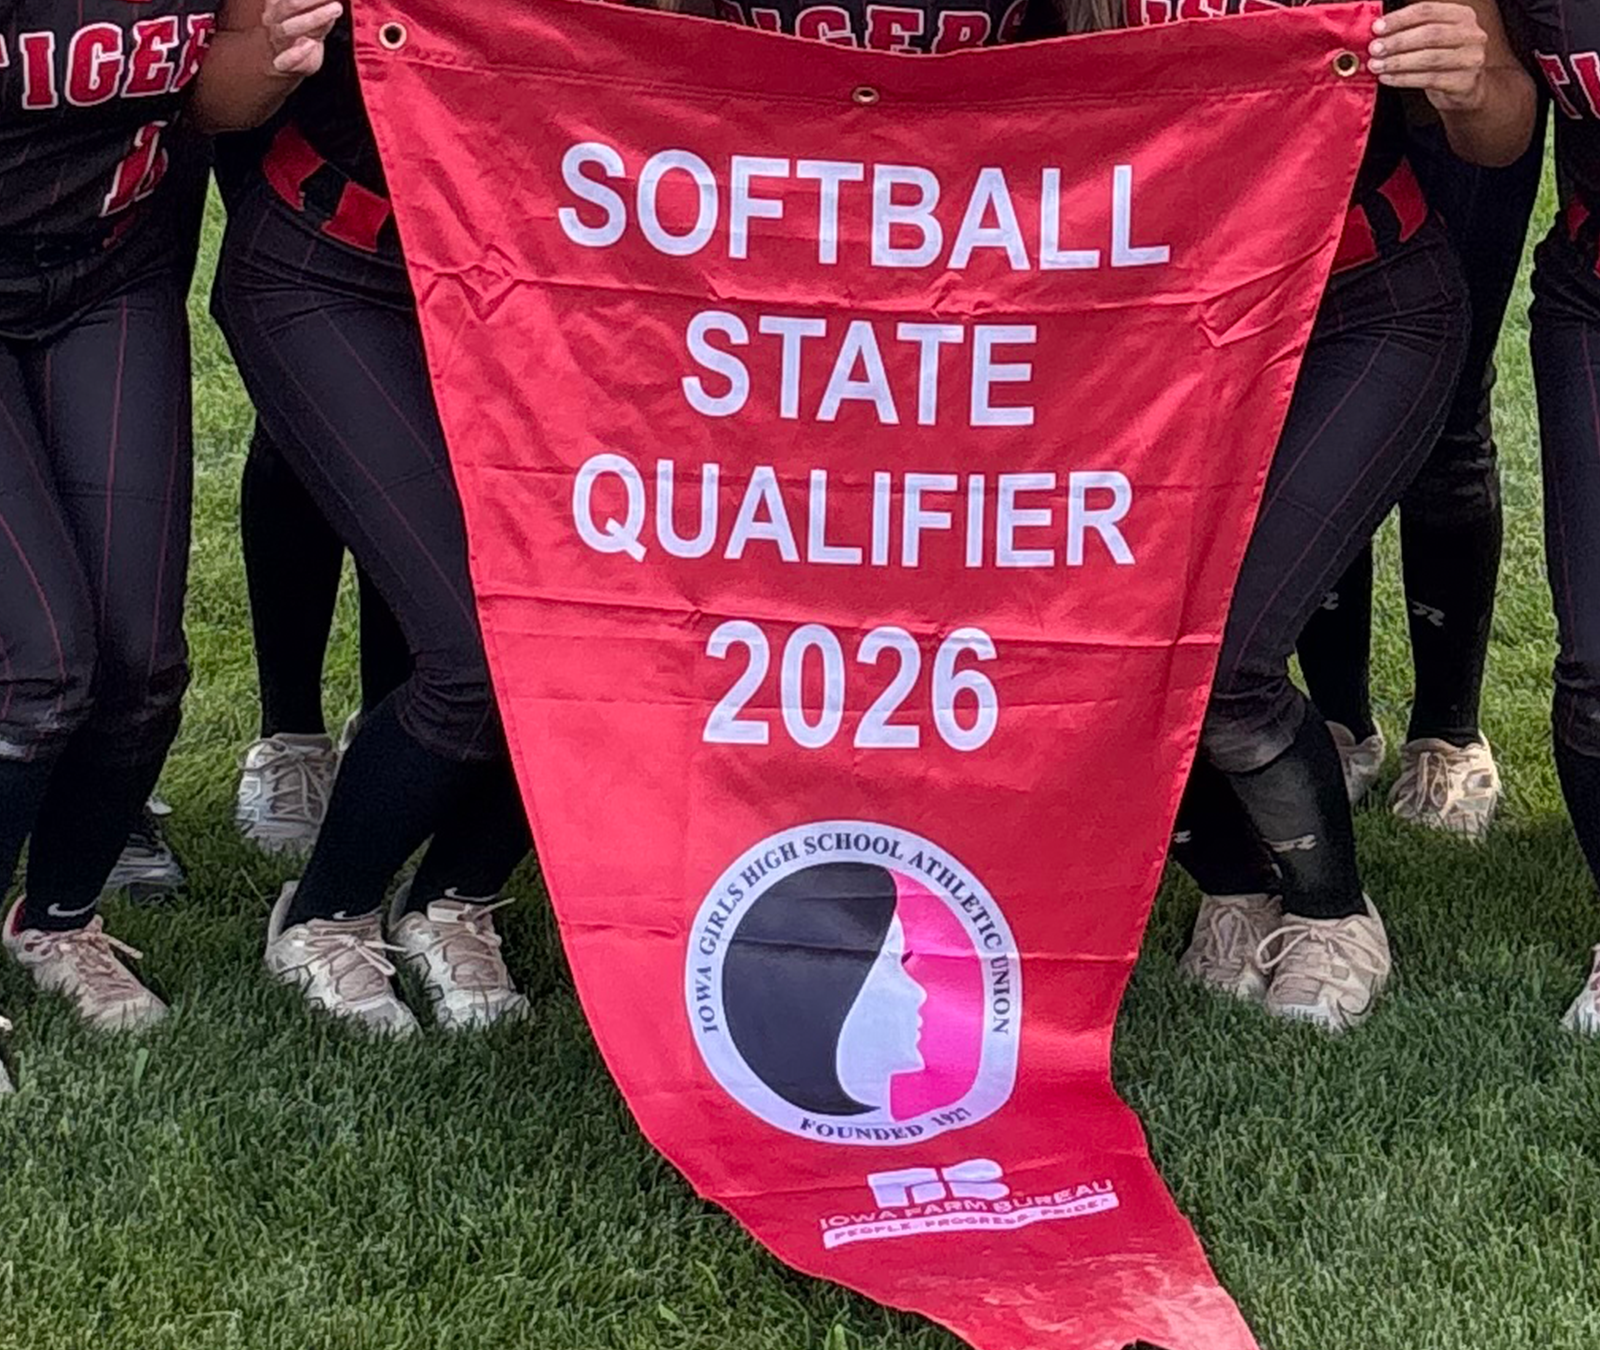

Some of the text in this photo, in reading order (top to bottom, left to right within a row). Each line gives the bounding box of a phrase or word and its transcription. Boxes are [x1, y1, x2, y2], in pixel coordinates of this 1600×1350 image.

[557, 141, 1171, 271] SOFTBALL
[681, 310, 1037, 426] STATE
[572, 453, 1136, 568] QUALIFIER
[702, 620, 1000, 752] 2026
[695, 832, 1011, 1035] IOWA GIRLS HIGH SCHOOL ATHLETIC UNION
[799, 1117, 925, 1141] FOUNDED
[819, 1178, 1114, 1230] IOWA FARM BUREAU
